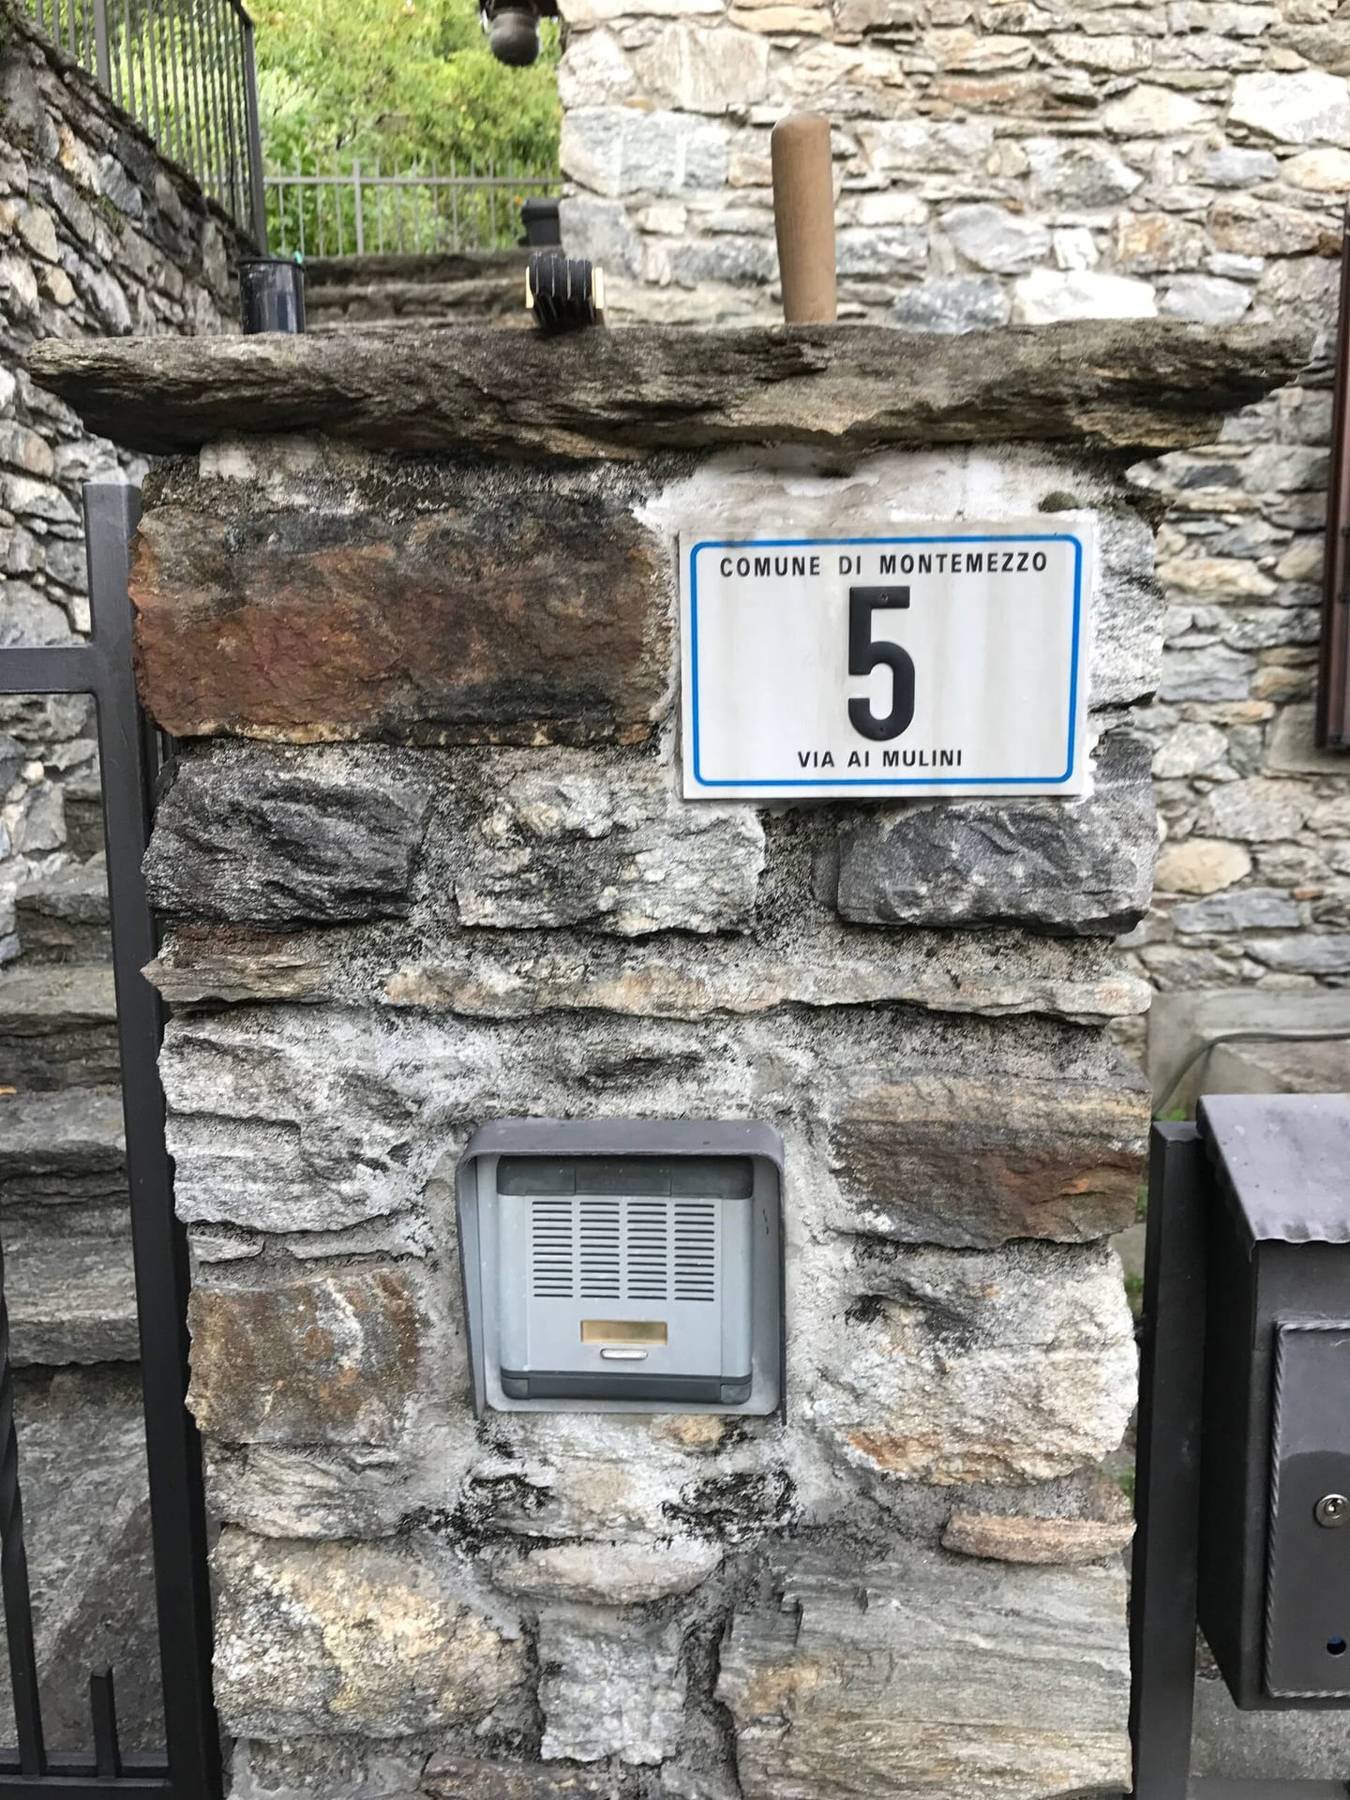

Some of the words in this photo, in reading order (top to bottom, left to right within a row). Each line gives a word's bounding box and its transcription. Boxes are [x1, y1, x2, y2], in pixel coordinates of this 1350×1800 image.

[720, 556, 820, 578] COMUNE
[839, 555, 861, 575] DI
[879, 551, 1047, 575] MONTEMEZZO
[848, 586, 915, 741] 5
[798, 751, 835, 768] VIA
[847, 750, 869, 767] AI
[882, 749, 962, 767] MULINI
